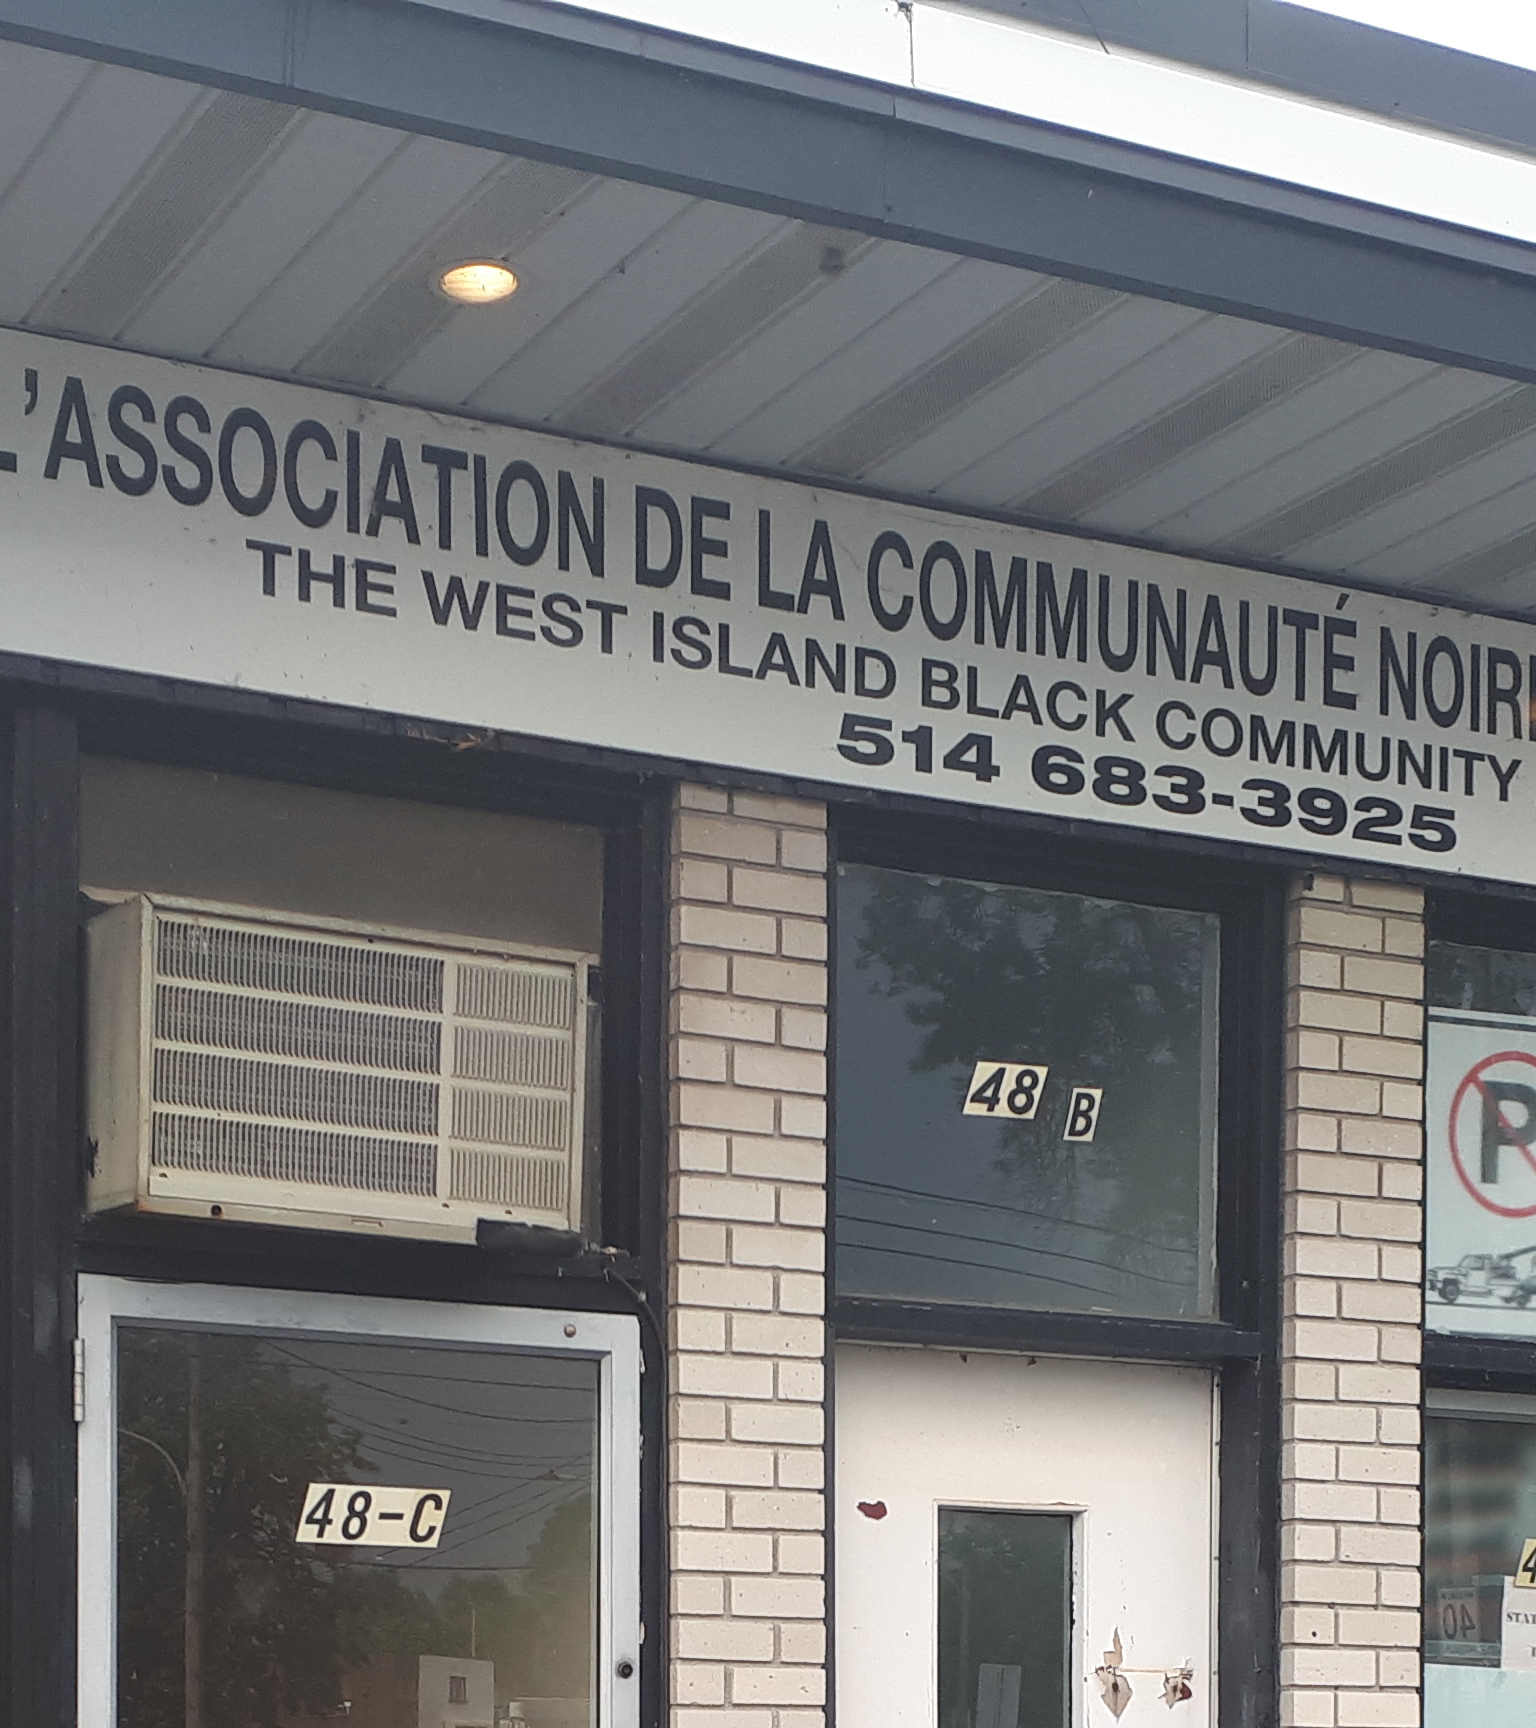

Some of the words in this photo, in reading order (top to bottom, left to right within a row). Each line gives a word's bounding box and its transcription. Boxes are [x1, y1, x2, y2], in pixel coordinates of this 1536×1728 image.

[636, 484, 731, 600] DE
[758, 509, 845, 621] LA
[867, 530, 1358, 711] COMMUNAUTÉ
[246, 538, 398, 618] THE
[421, 570, 628, 655] WEST
[653, 611, 897, 701] ISLAND
[920, 657, 1135, 742] BLACK
[1156, 700, 1522, 802] COMMUNITY
[837, 713, 1001, 783] 514
[1031, 744, 1458, 853] 683-3925
[969, 1067, 1039, 1115] 48
[1067, 1092, 1096, 1137] B
[304, 1488, 443, 1543] 48-C
